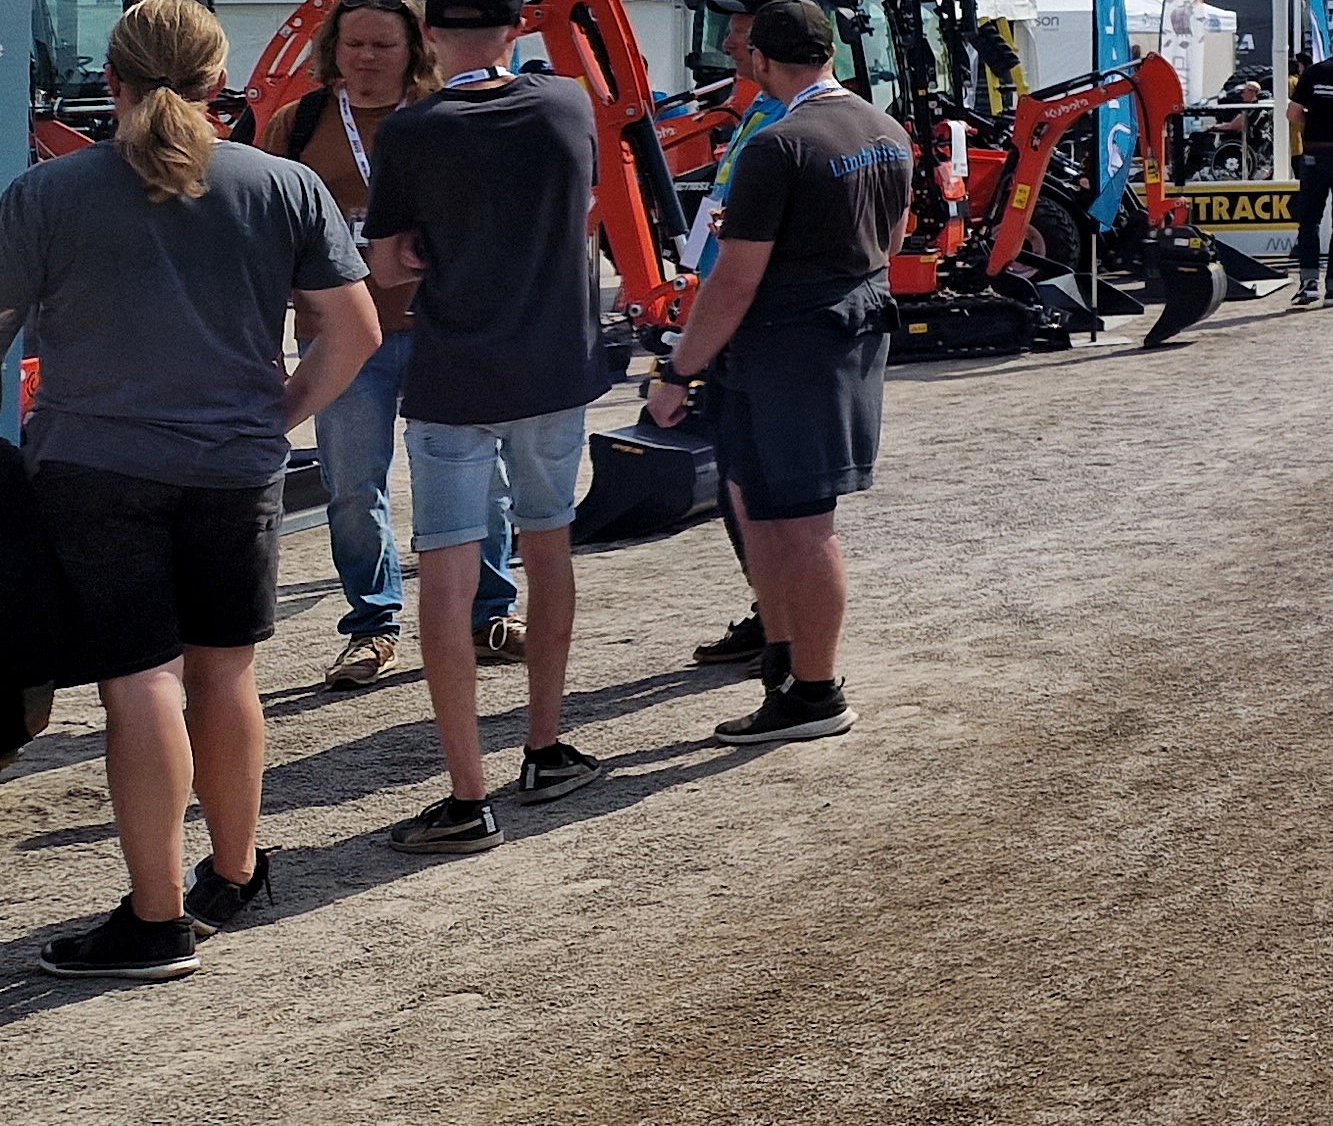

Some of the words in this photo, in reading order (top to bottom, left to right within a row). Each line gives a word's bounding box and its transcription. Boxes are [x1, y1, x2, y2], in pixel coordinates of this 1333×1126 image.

[1035, 16, 1060, 27] son
[1043, 99, 1089, 120] Kubota
[1196, 194, 1292, 221] TRACK
